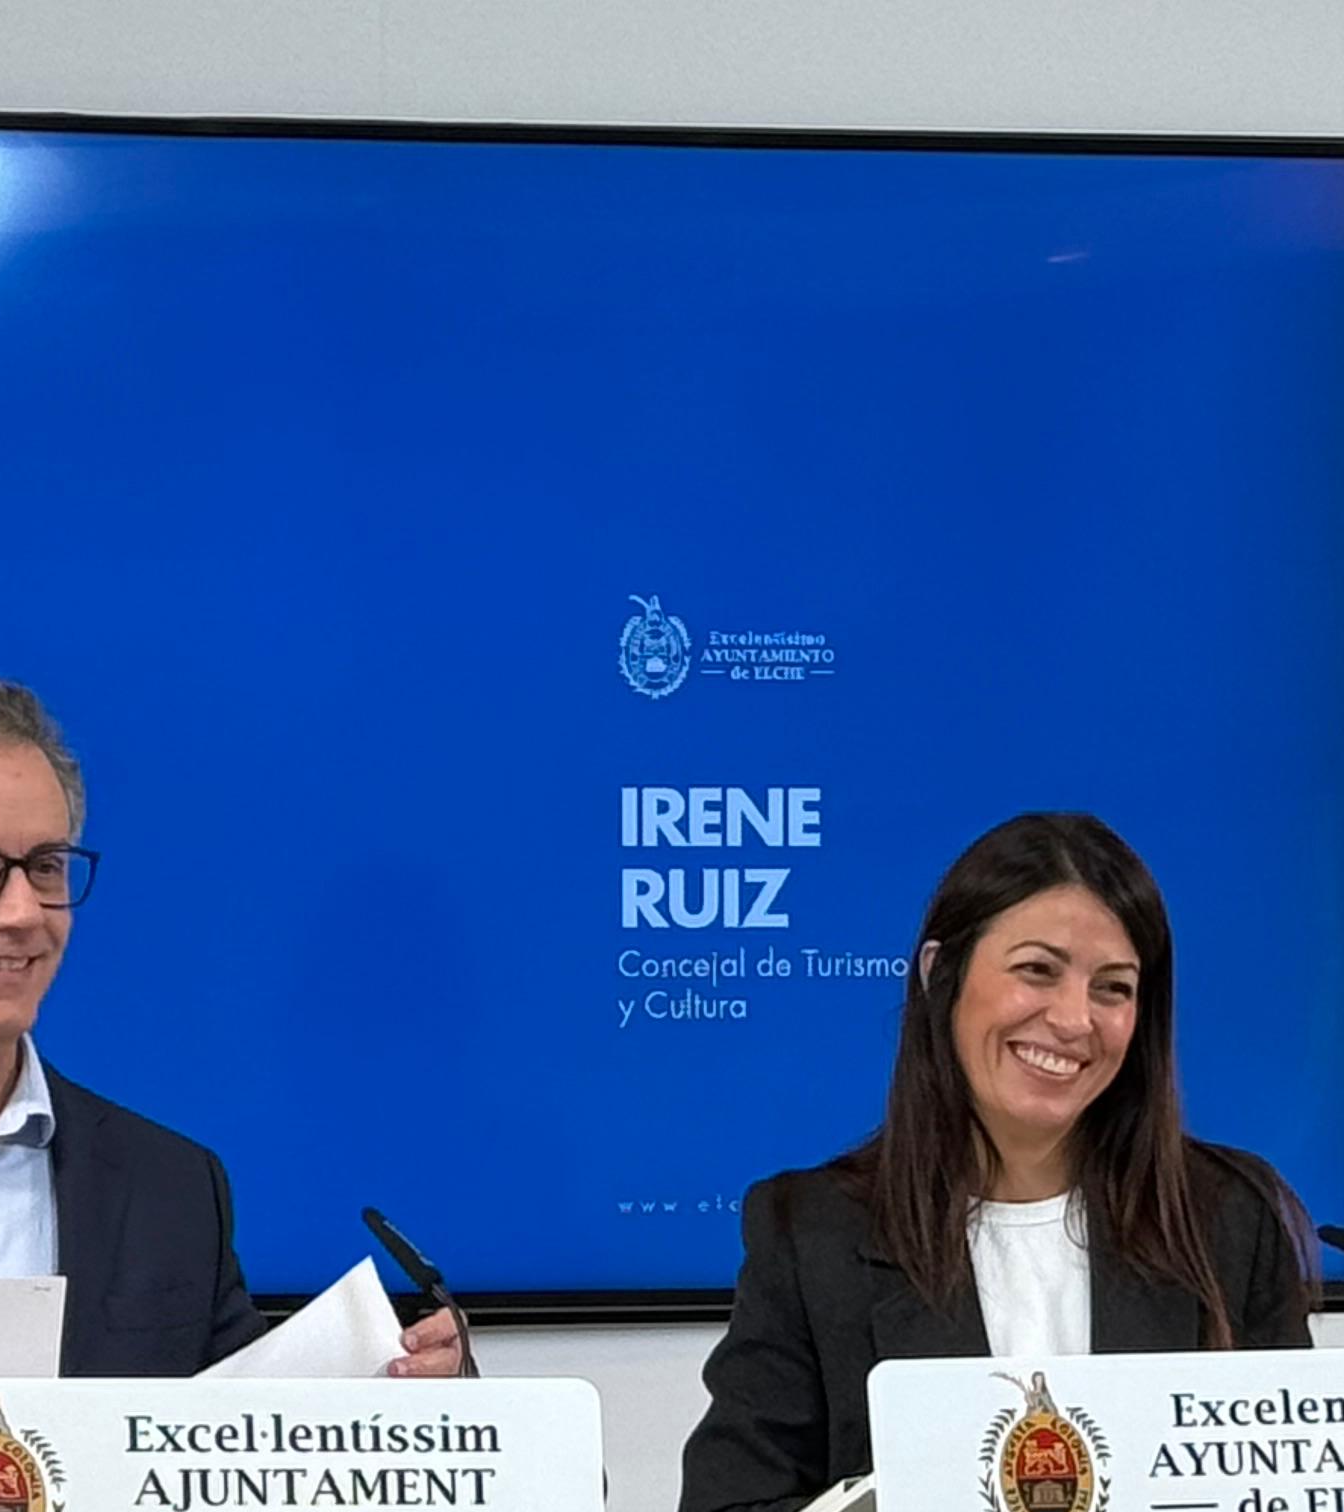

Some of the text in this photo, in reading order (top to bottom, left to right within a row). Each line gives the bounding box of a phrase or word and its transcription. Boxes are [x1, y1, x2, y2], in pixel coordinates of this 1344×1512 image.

[700, 648, 834, 663] AYUNTAMIENTO
[753, 666, 805, 680] ELCHE
[621, 787, 822, 847] IRENE
[621, 868, 791, 928] RUIZ
[618, 946, 909, 988] Concejal de Turismo
[618, 988, 747, 1028] y Cultura
[124, 1413, 502, 1453] Excel·lentíssim
[134, 1468, 496, 1512] AJUNTAMENT
